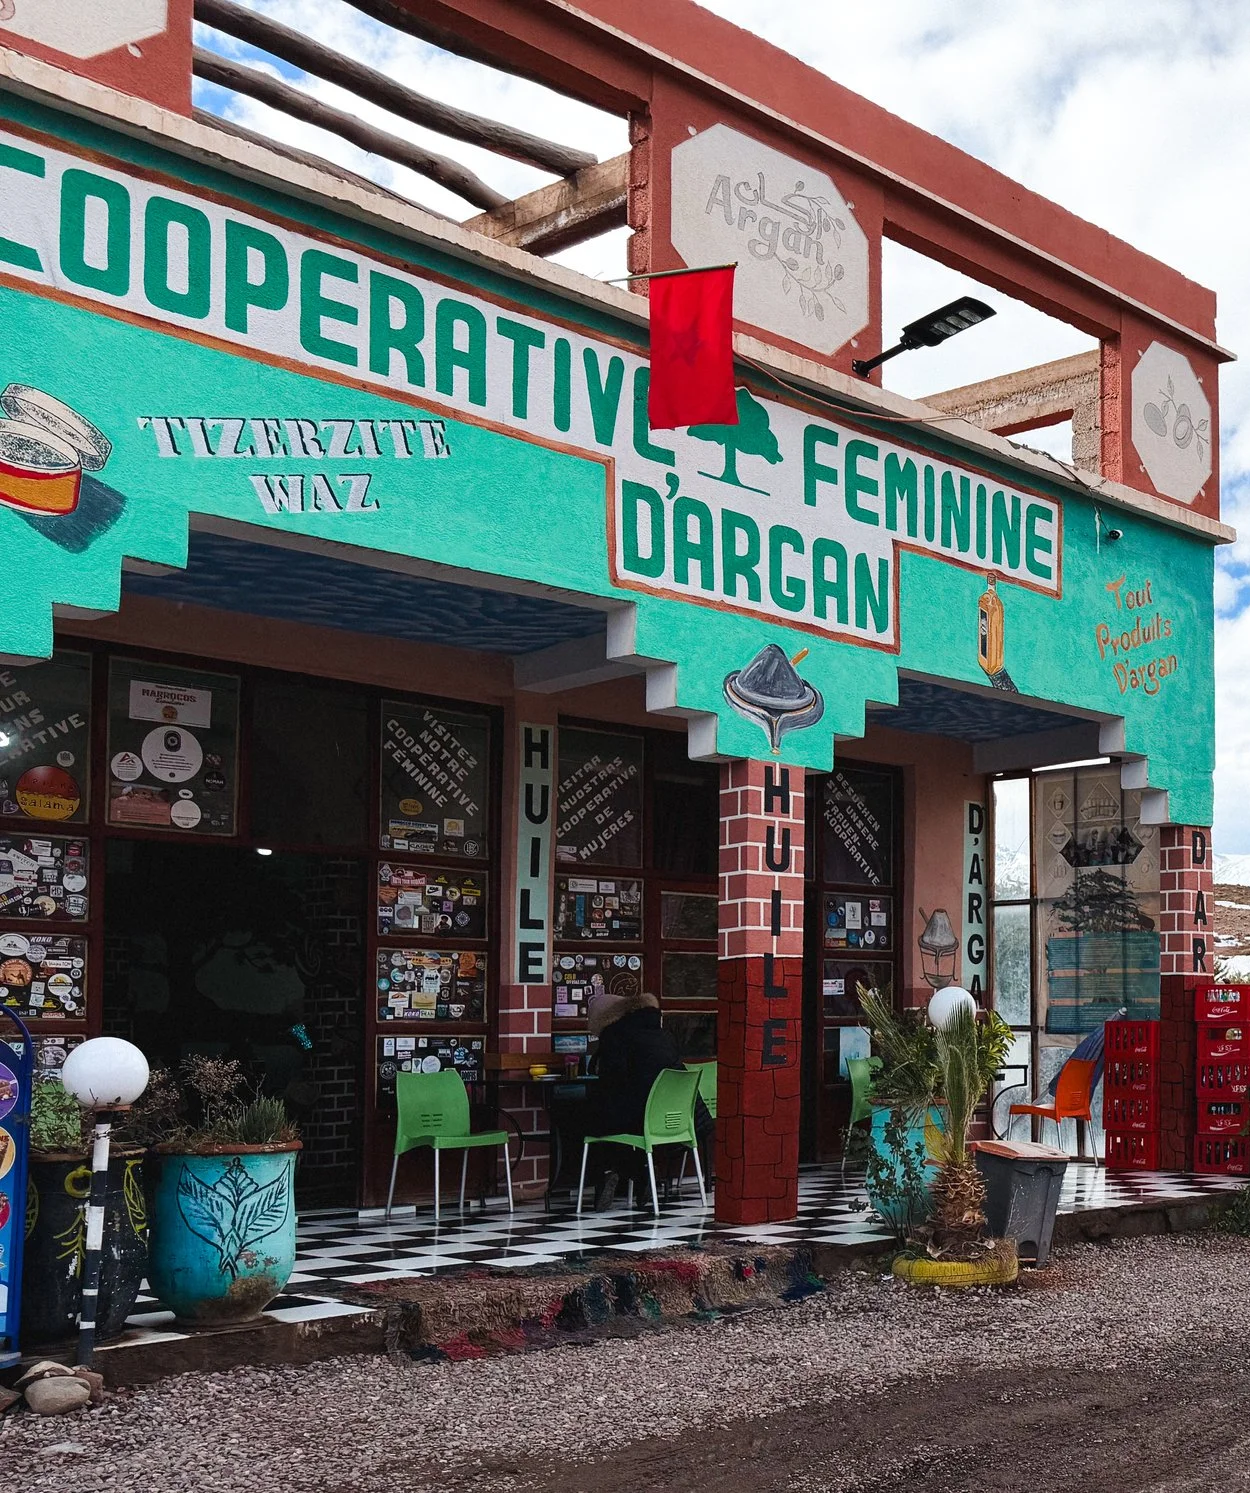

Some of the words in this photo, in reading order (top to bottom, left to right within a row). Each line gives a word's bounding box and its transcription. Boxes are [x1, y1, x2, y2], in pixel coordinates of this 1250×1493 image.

[705, 174, 824, 266] Argan
[136, 416, 451, 459] TIZERZITE
[248, 473, 380, 514] WAZ
[802, 423, 1053, 580] FEMININE
[621, 466, 889, 634] D'ARGAN
[1105, 573, 1152, 610] Tout
[1096, 612, 1172, 660] Produits
[0, 690, 31, 713] UR
[419, 729, 469, 782] NOTRE
[423, 710, 478, 769] VISITEZ
[556, 764, 638, 839] COOPERATIVA
[558, 754, 602, 794] ISITAR
[835, 772, 880, 832] BESUCHEN
[579, 809, 635, 860] MUJERES
[594, 806, 614, 825] DE
[519, 726, 550, 984] HUILE
[823, 809, 880, 887] KOOPERATIVE
[761, 765, 791, 1065] HUILE
[968, 803, 985, 1010] D'ARGA
